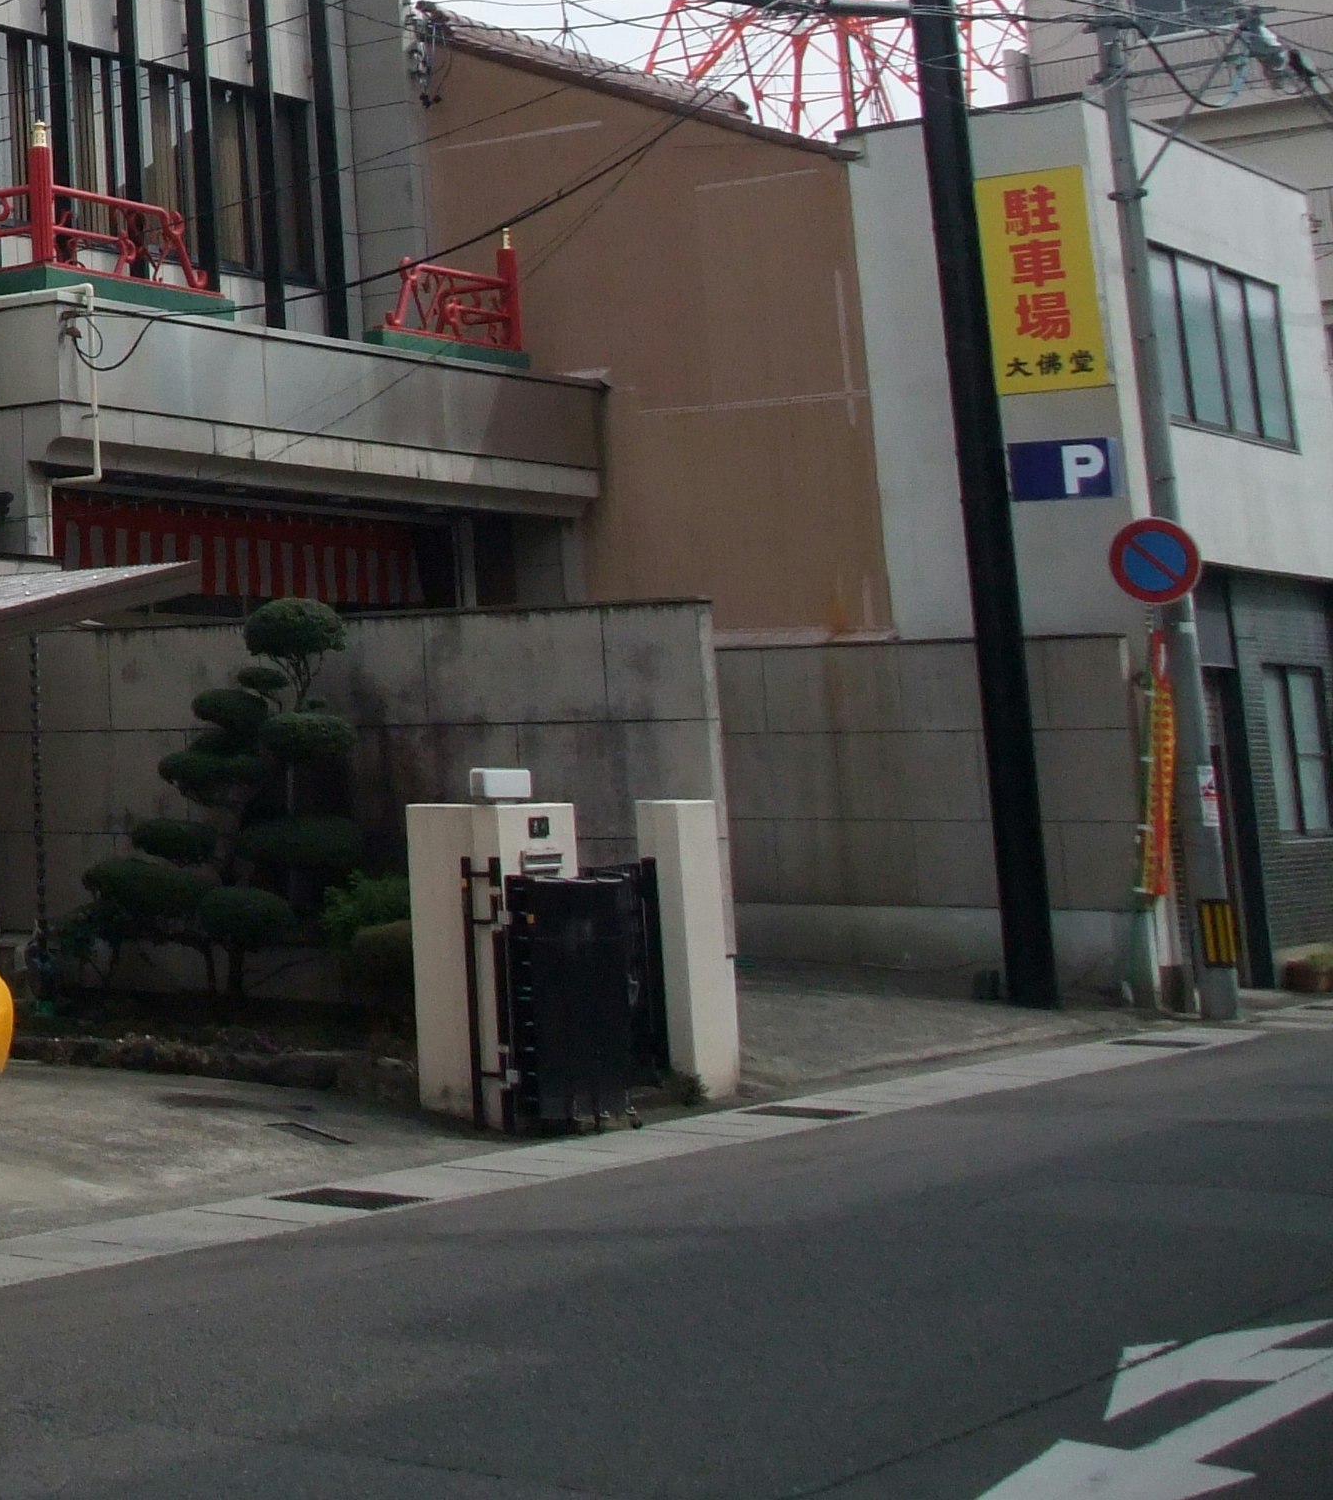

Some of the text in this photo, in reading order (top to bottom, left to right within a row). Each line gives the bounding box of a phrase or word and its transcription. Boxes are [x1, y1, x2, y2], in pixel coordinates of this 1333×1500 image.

[1003, 184, 1071, 341] 駐車場
[1005, 350, 1095, 377] 大佛堂
[1061, 444, 1105, 495] P
